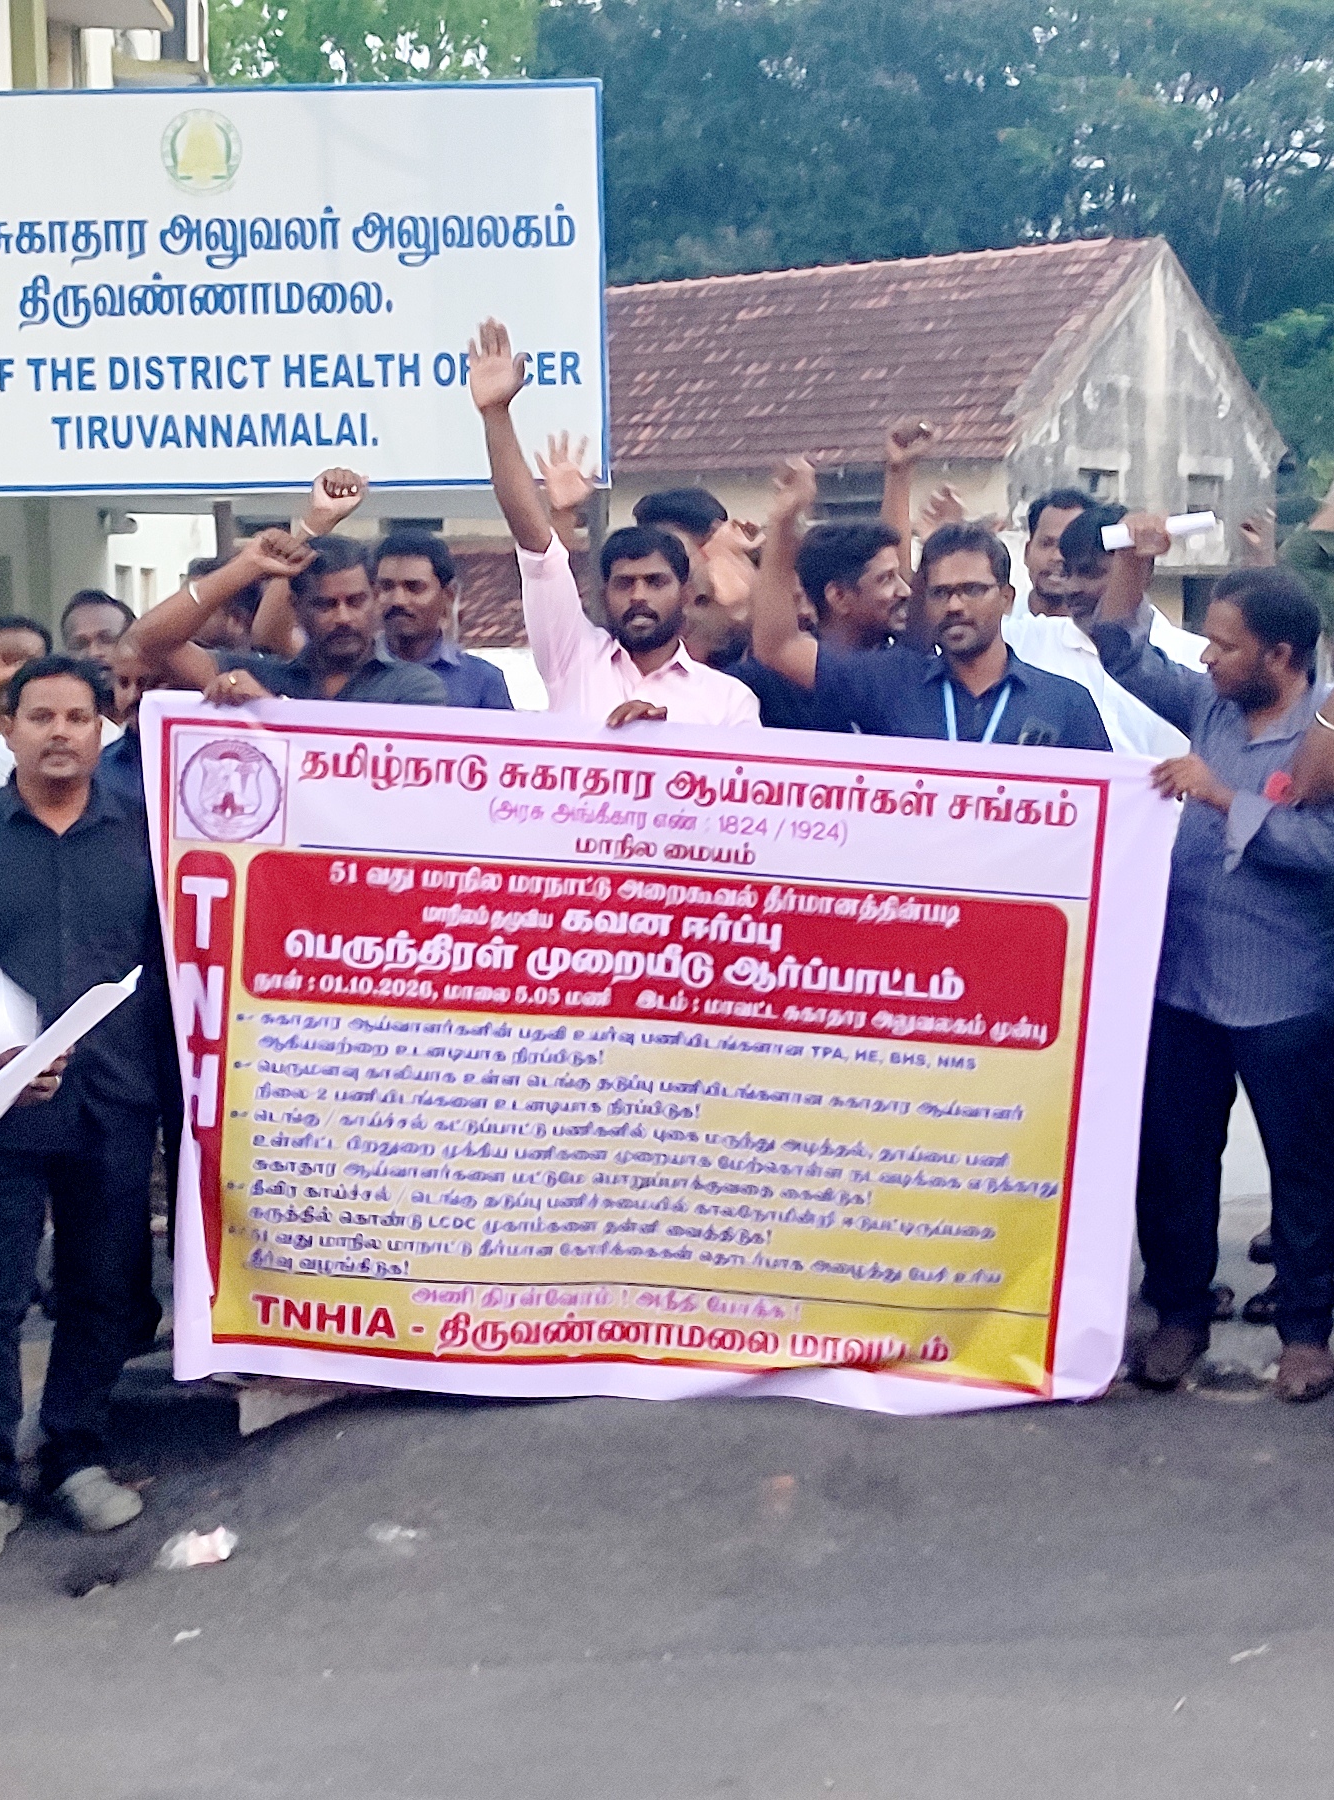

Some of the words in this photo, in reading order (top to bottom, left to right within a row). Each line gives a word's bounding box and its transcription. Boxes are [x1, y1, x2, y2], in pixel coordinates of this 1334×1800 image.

[159, 205, 340, 270] அலுவலர்
[352, 203, 575, 267] அலுவலகம்
[19, 272, 393, 329] திருவண்ணாமலை.
[26, 357, 96, 392] THE
[108, 354, 271, 391] DISTRICT
[283, 353, 420, 388] HEALTH
[433, 351, 582, 387] OFCER
[51, 412, 378, 450] TIRUVANNAMALAI.
[300, 742, 487, 791] தமிழ்நாடு
[499, 762, 654, 804] சுகாதார
[666, 766, 936, 816] ஆய்வாளர்கள்
[948, 785, 1077, 826] சங்கம்
[575, 832, 657, 859] மாநில
[663, 842, 755, 865] மையம்
[330, 860, 357, 883] 51
[366, 866, 414, 892] வது
[421, 866, 502, 893] மாநில
[508, 875, 611, 900] மாநாட்டு
[617, 879, 757, 912] அறைகூவல்
[763, 886, 959, 927] தீர்மானத்தின்படி
[561, 908, 674, 939] கவன
[681, 912, 781, 951] ஈர்ப்பு
[285, 929, 516, 972] பெருந்திரள்
[526, 943, 713, 988] முறையீடு
[723, 955, 963, 1000] ஆர்ப்பாட்டம்
[428, 1216, 473, 1229] LCDC
[253, 1294, 395, 1338] TNHIA
[440, 1313, 778, 1351] திருவண்ணாமலை
